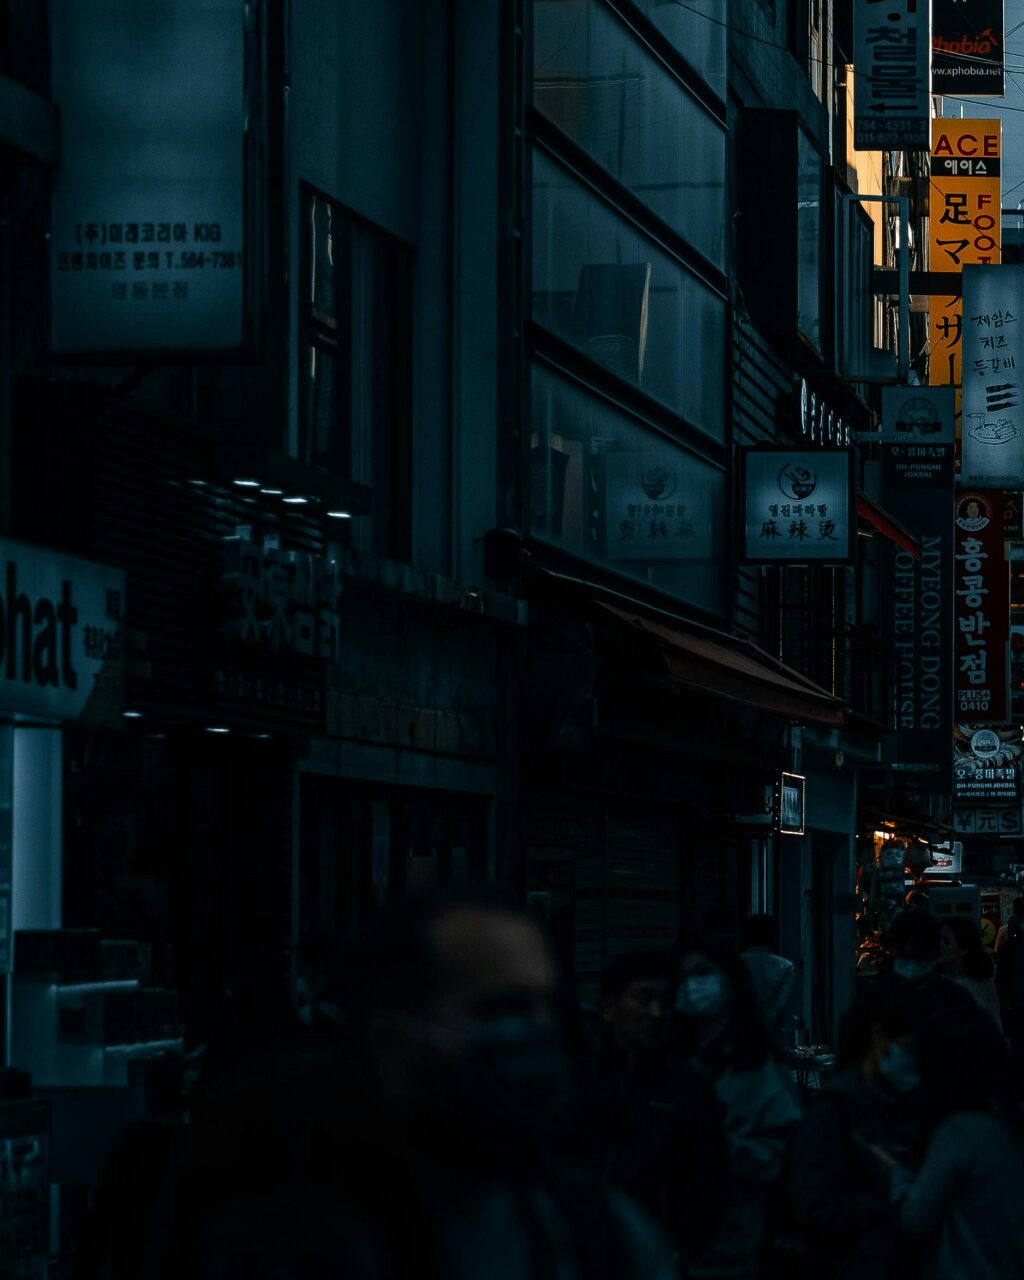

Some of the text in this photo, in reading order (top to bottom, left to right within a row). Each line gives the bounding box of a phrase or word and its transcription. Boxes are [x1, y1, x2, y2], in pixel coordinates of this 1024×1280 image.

[934, 134, 998, 156] ACE
[944, 159, 987, 175] 에이스
[970, 309, 1018, 329] 제임스
[979, 334, 1008, 350] 치즈
[971, 356, 1016, 377] 등갈비
[758, 520, 841, 541] 麻辣烫
[955, 536, 991, 685] 홍콩반점
[920, 536, 942, 729] MYEONG DONG
[959, 701, 989, 712] 0410
